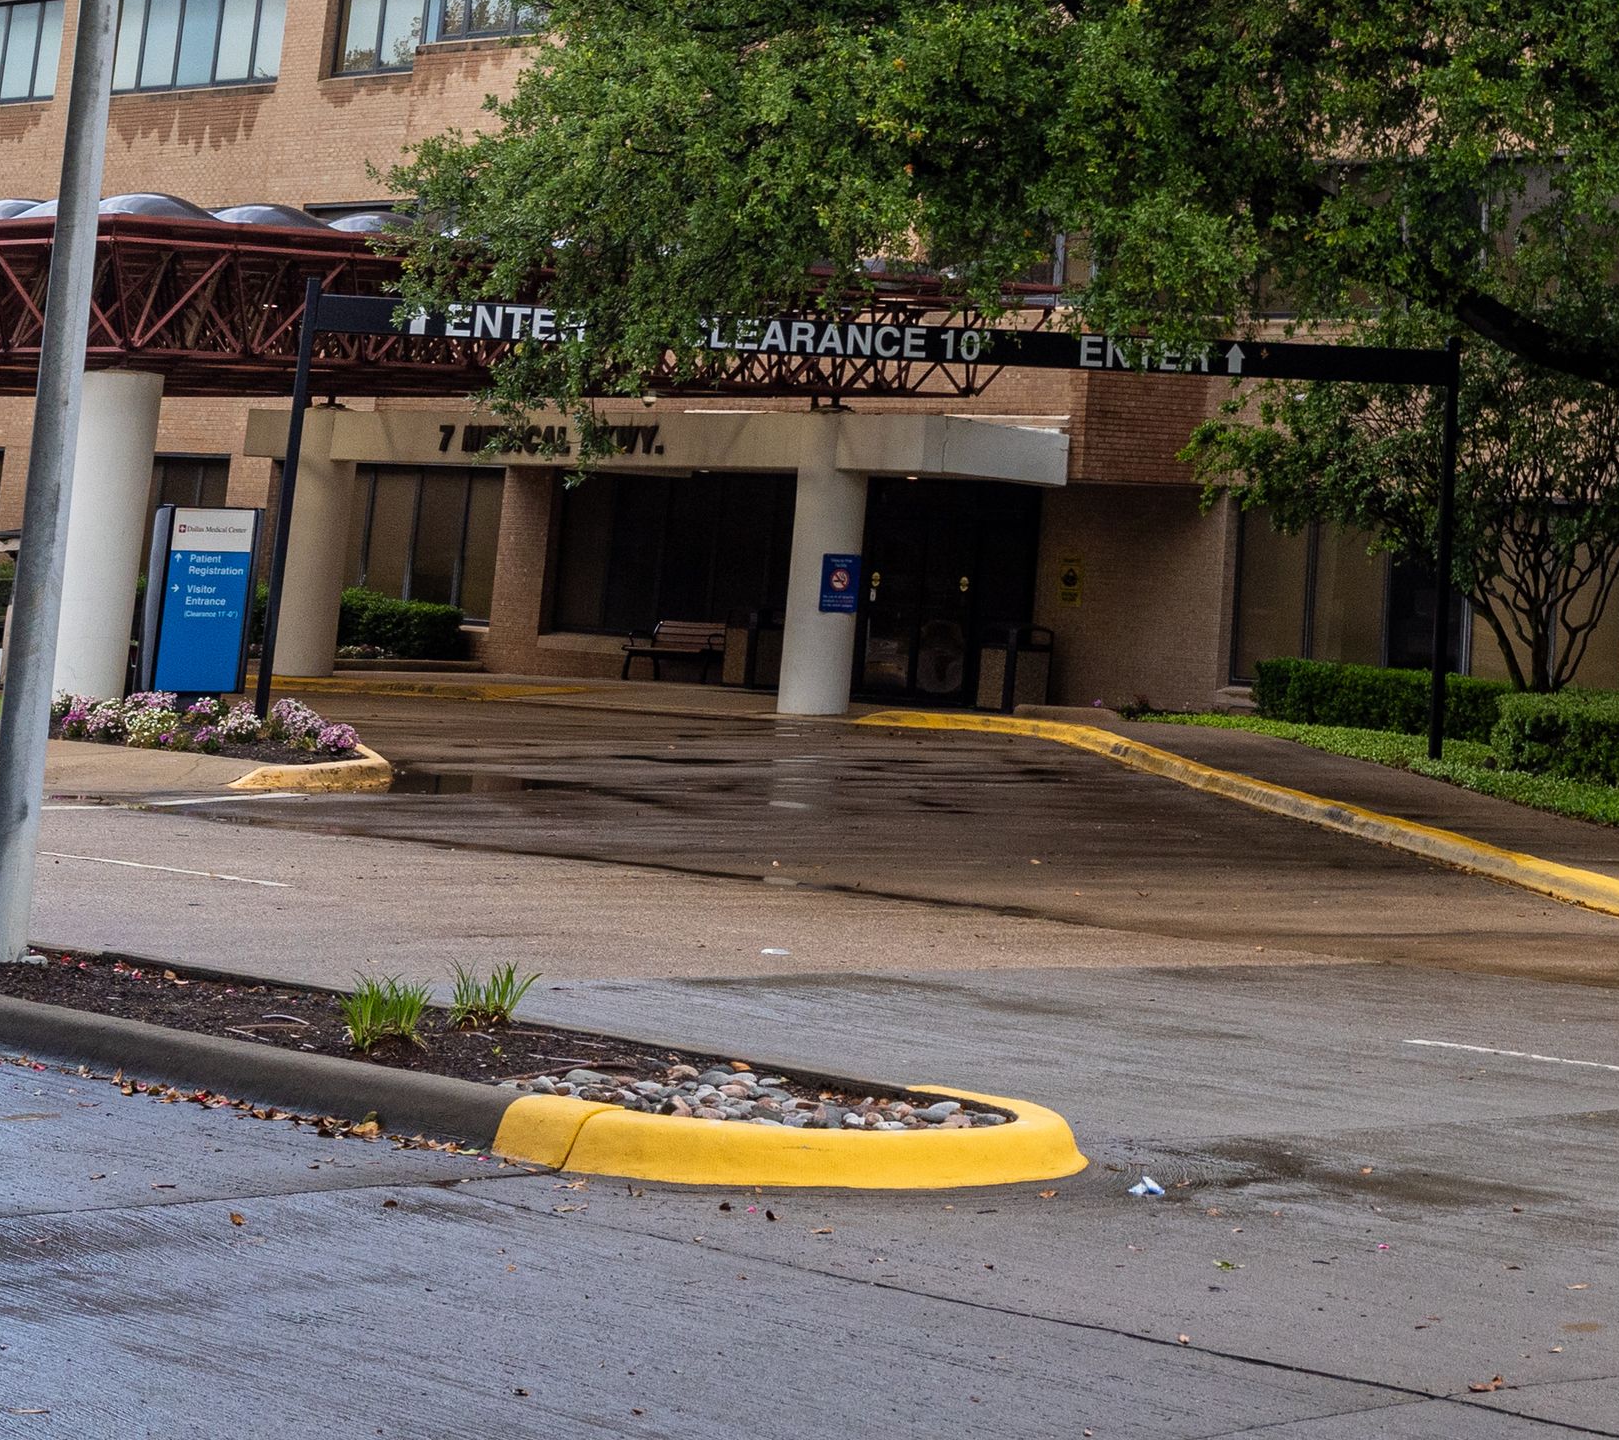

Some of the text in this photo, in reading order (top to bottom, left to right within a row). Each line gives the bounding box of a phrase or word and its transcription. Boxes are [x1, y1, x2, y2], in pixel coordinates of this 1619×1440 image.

[439, 425, 456, 452] 7
[187, 525, 247, 534] Dallas Medical Center
[190, 554, 222, 563] Patient
[188, 566, 244, 577] Registration
[187, 584, 216, 594] Visitor
[185, 596, 226, 606] Entrance
